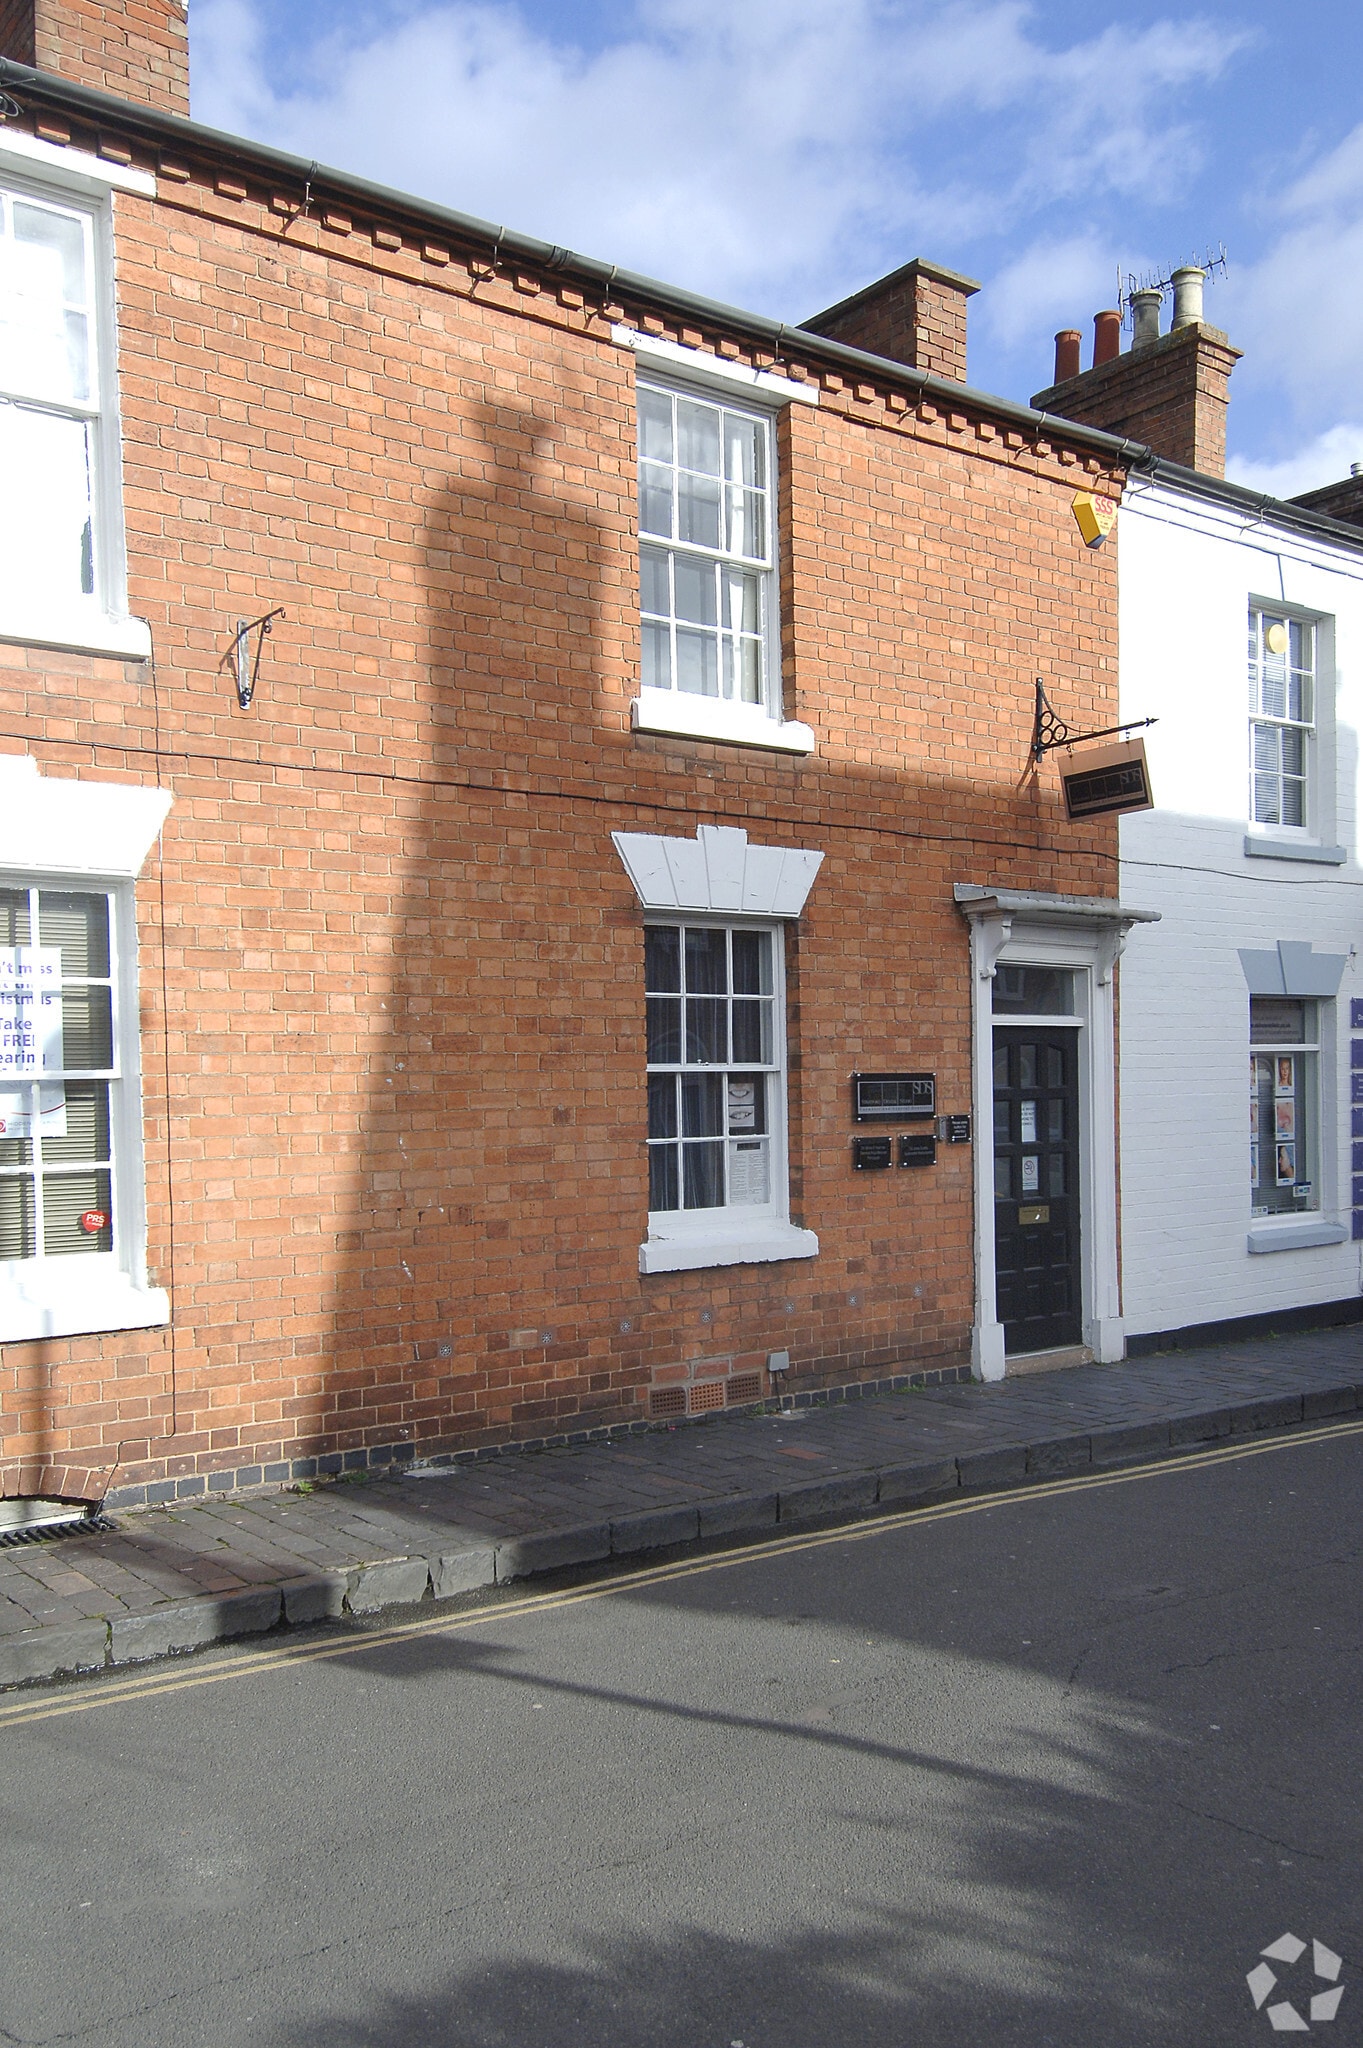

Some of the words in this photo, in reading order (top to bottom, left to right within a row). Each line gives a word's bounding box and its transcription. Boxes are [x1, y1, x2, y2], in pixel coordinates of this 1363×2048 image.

[1095, 495, 1113, 515] SSS
[18, 964, 53, 974] mss
[1, 992, 52, 1005] istms
[3, 1034, 35, 1046] FRE
[0, 1050, 46, 1065] arin
[86, 1213, 105, 1223] PRS
